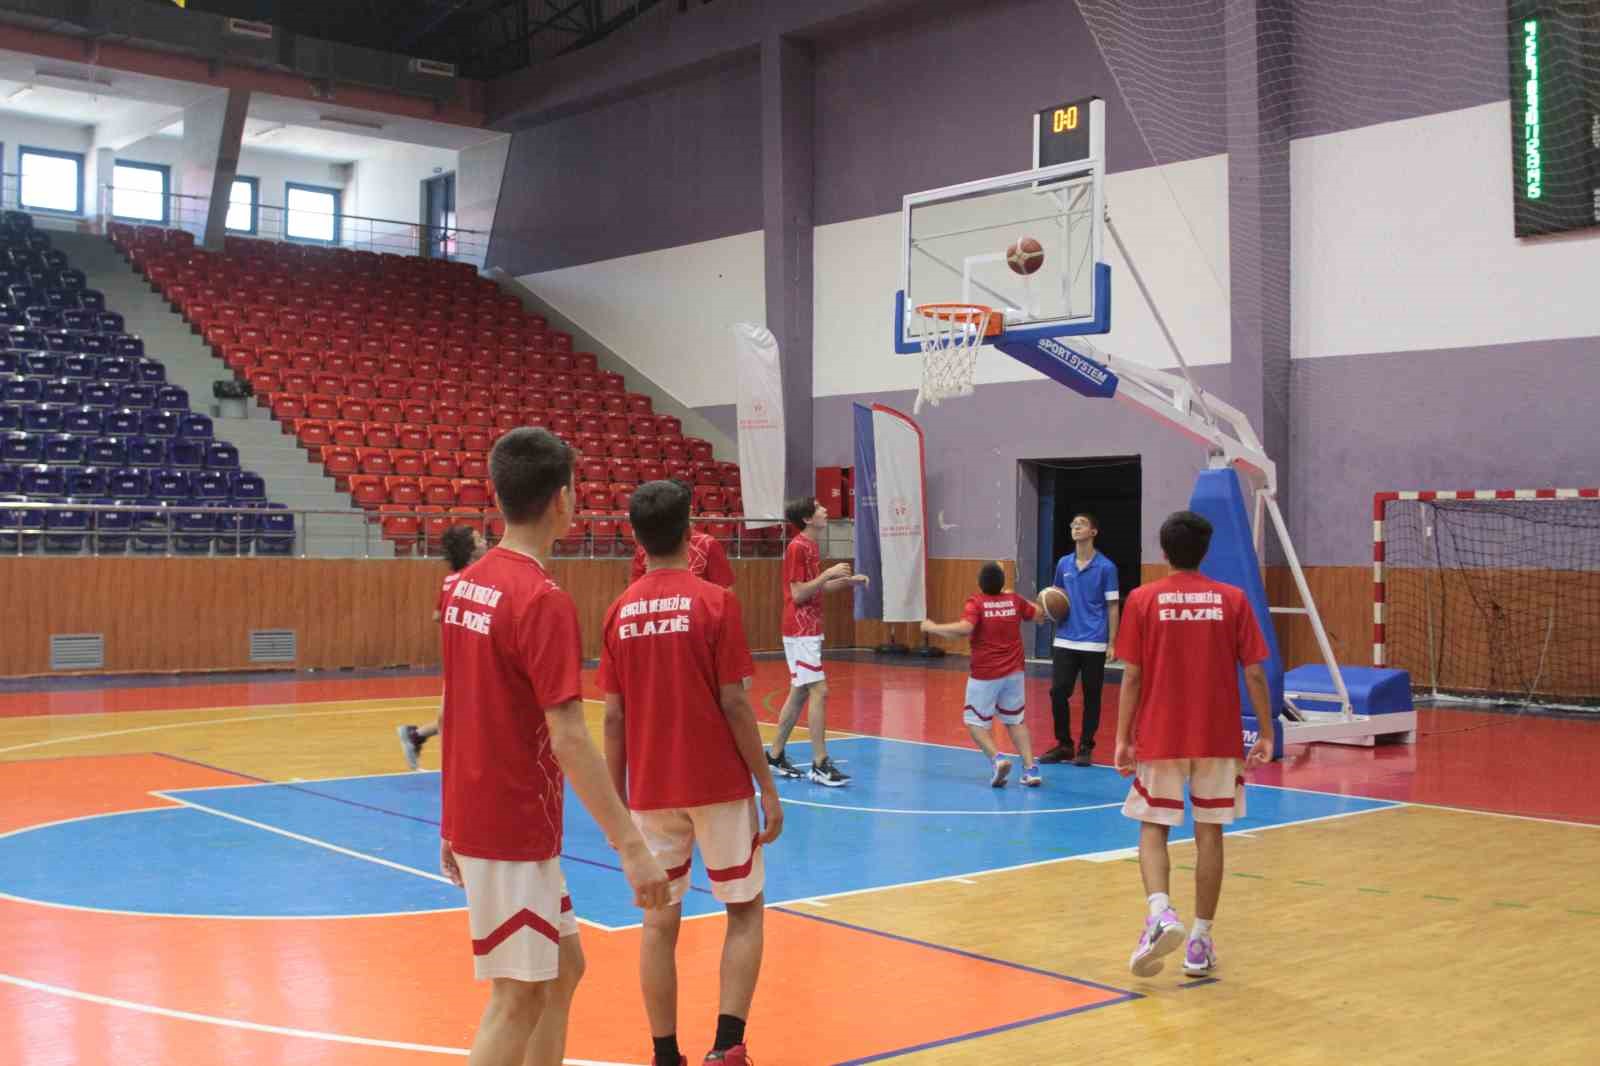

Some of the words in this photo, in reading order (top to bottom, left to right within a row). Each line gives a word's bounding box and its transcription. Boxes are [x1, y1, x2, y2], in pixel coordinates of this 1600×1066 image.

[1038, 338, 1071, 361] SPORT
[1070, 354, 1108, 383] SYSTEM
[1159, 606, 1223, 621] ELAZIĞ
[619, 615, 689, 640] ELAZIĞ
